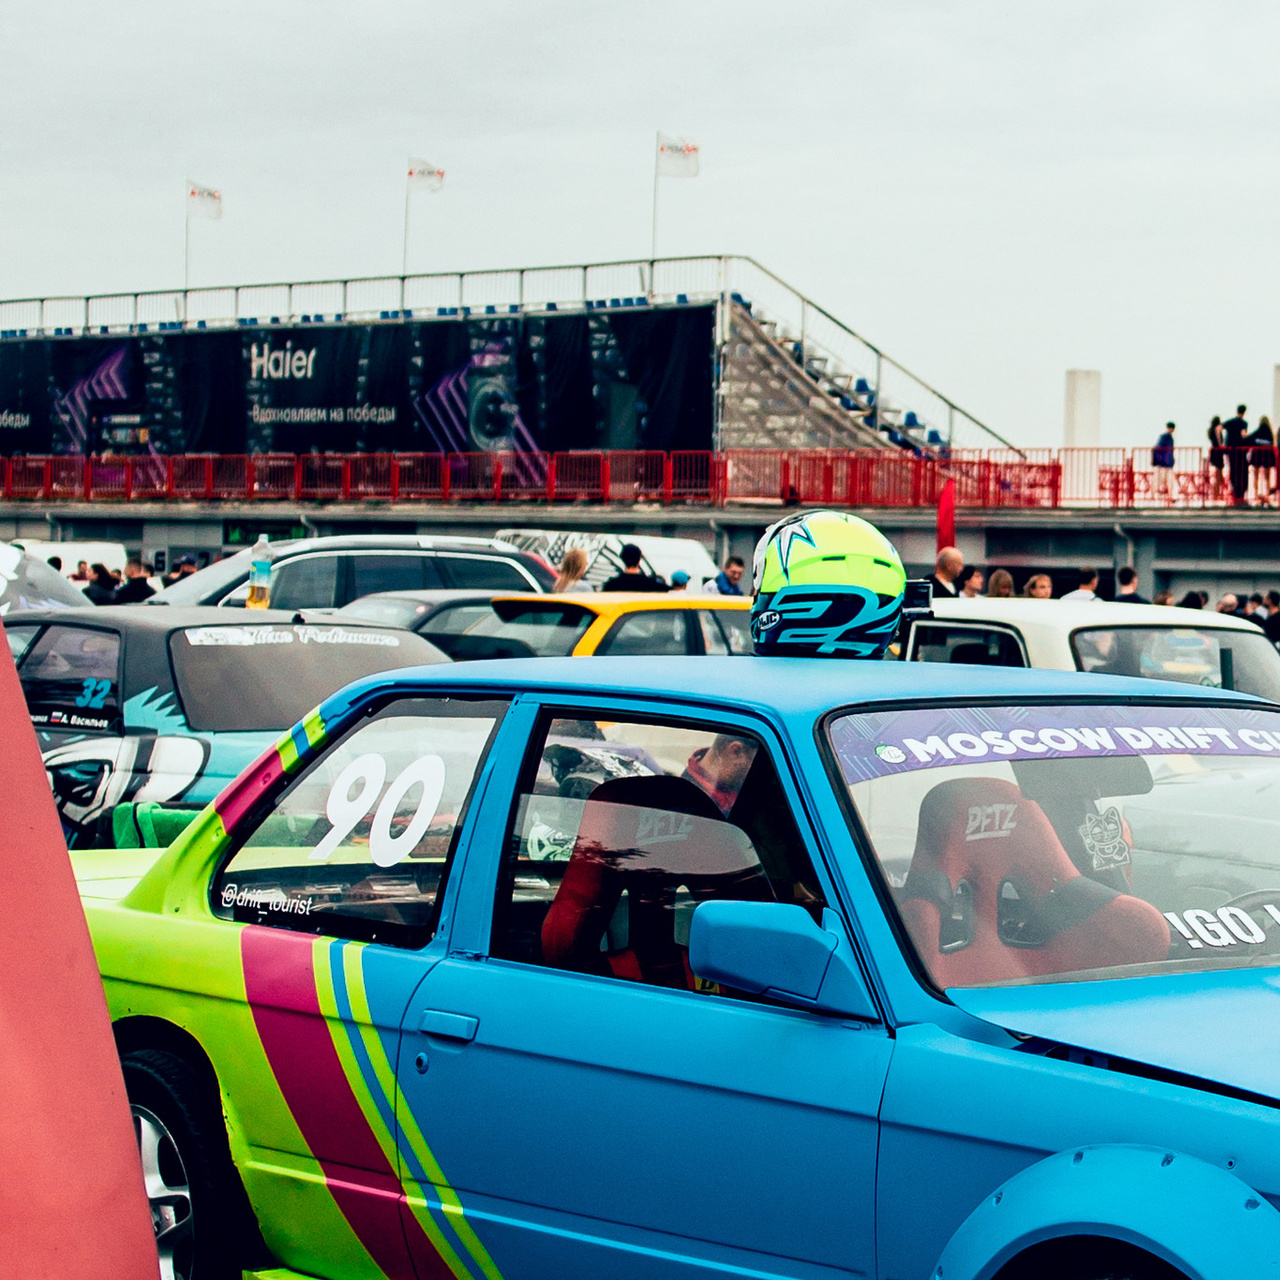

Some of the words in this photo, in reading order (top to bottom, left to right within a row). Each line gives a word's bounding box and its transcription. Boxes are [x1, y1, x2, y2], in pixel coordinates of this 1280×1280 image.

[251, 340, 316, 379] Haier
[0, 410, 30, 428] обеды
[253, 404, 326, 424] Вдохновляем
[330, 408, 344, 421] на
[347, 403, 396, 423] победы
[76, 677, 112, 709] 32
[902, 727, 1117, 763] MOSCOW
[1114, 726, 1239, 750] DRIFT
[307, 753, 446, 868] 90
[1163, 906, 1267, 949] !GO
